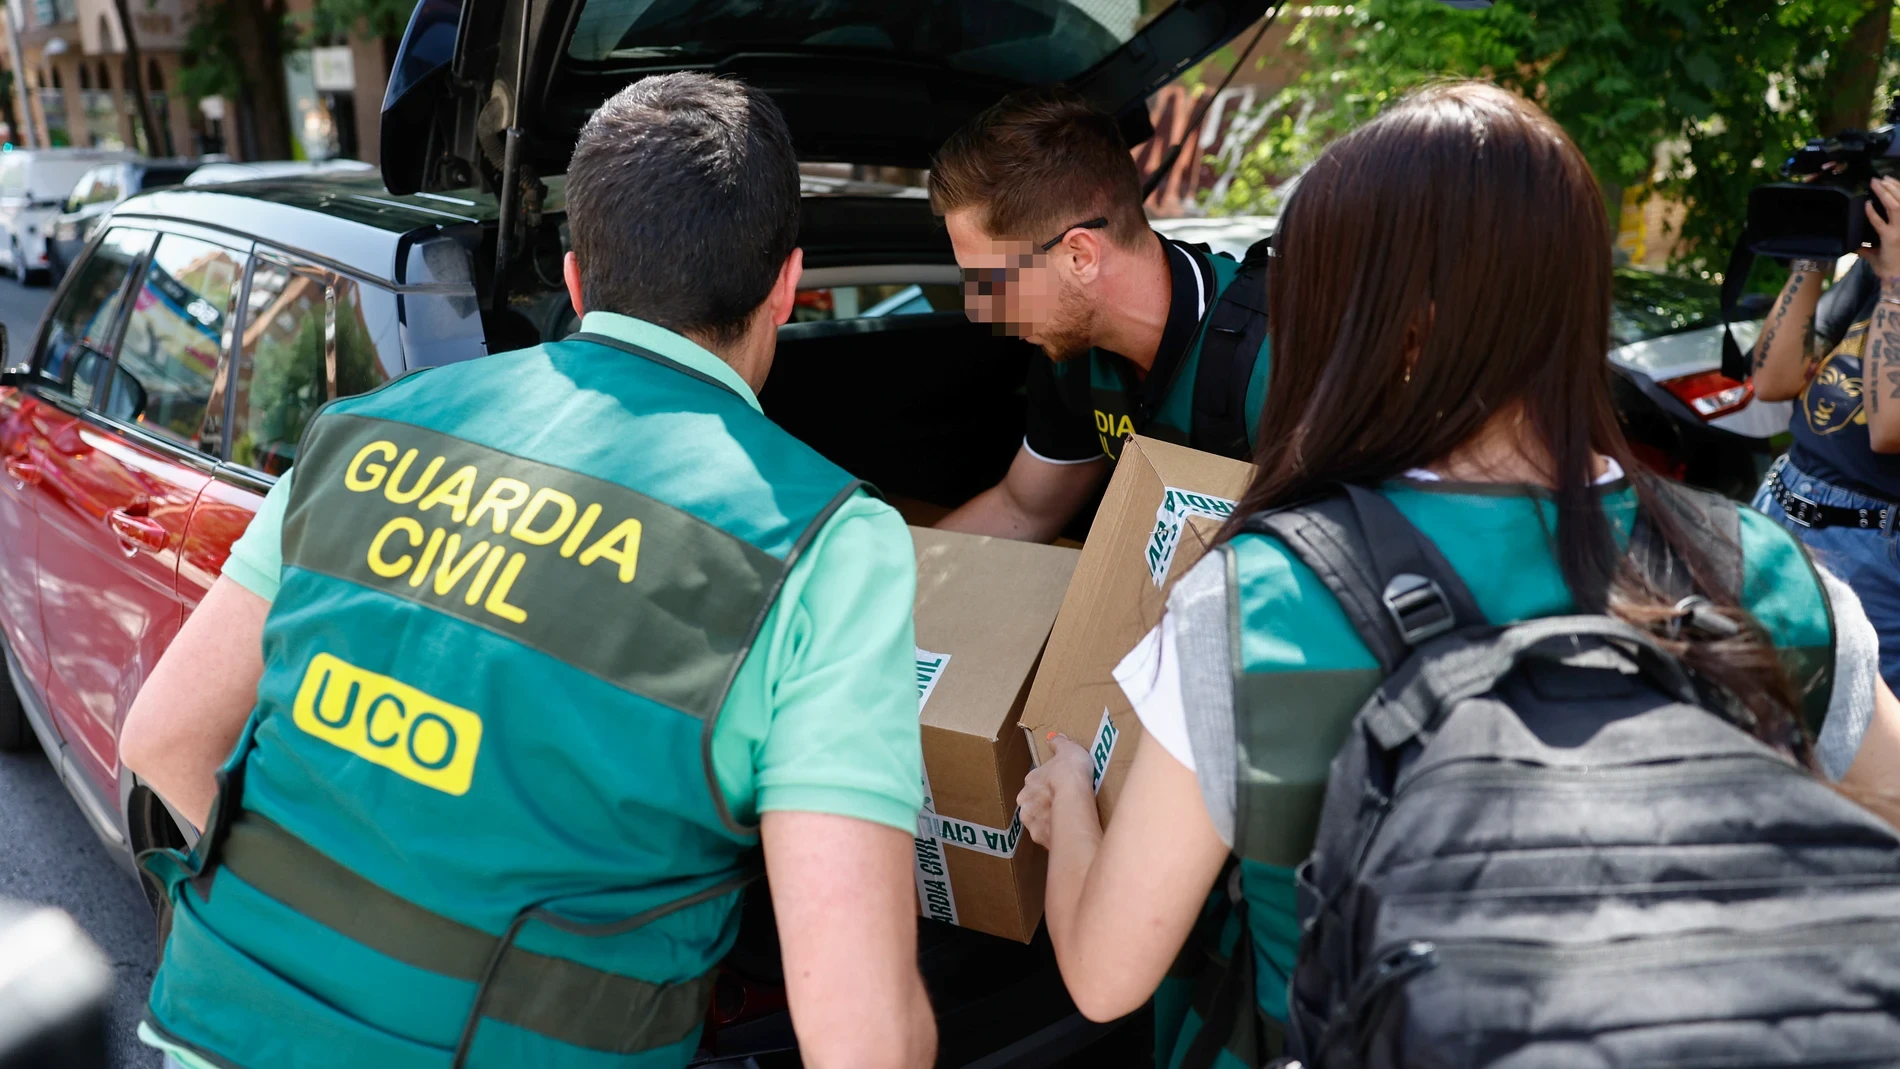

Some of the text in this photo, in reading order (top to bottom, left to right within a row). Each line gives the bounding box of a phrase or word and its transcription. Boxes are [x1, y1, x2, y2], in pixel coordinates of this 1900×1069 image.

[343, 440, 642, 583] GUARDIA
[1149, 520, 1174, 576] CIV
[367, 516, 529, 624] CIVIL
[916, 658, 943, 698] IVIL
[312, 668, 458, 770] UCO
[914, 836, 944, 876] CIVIL
